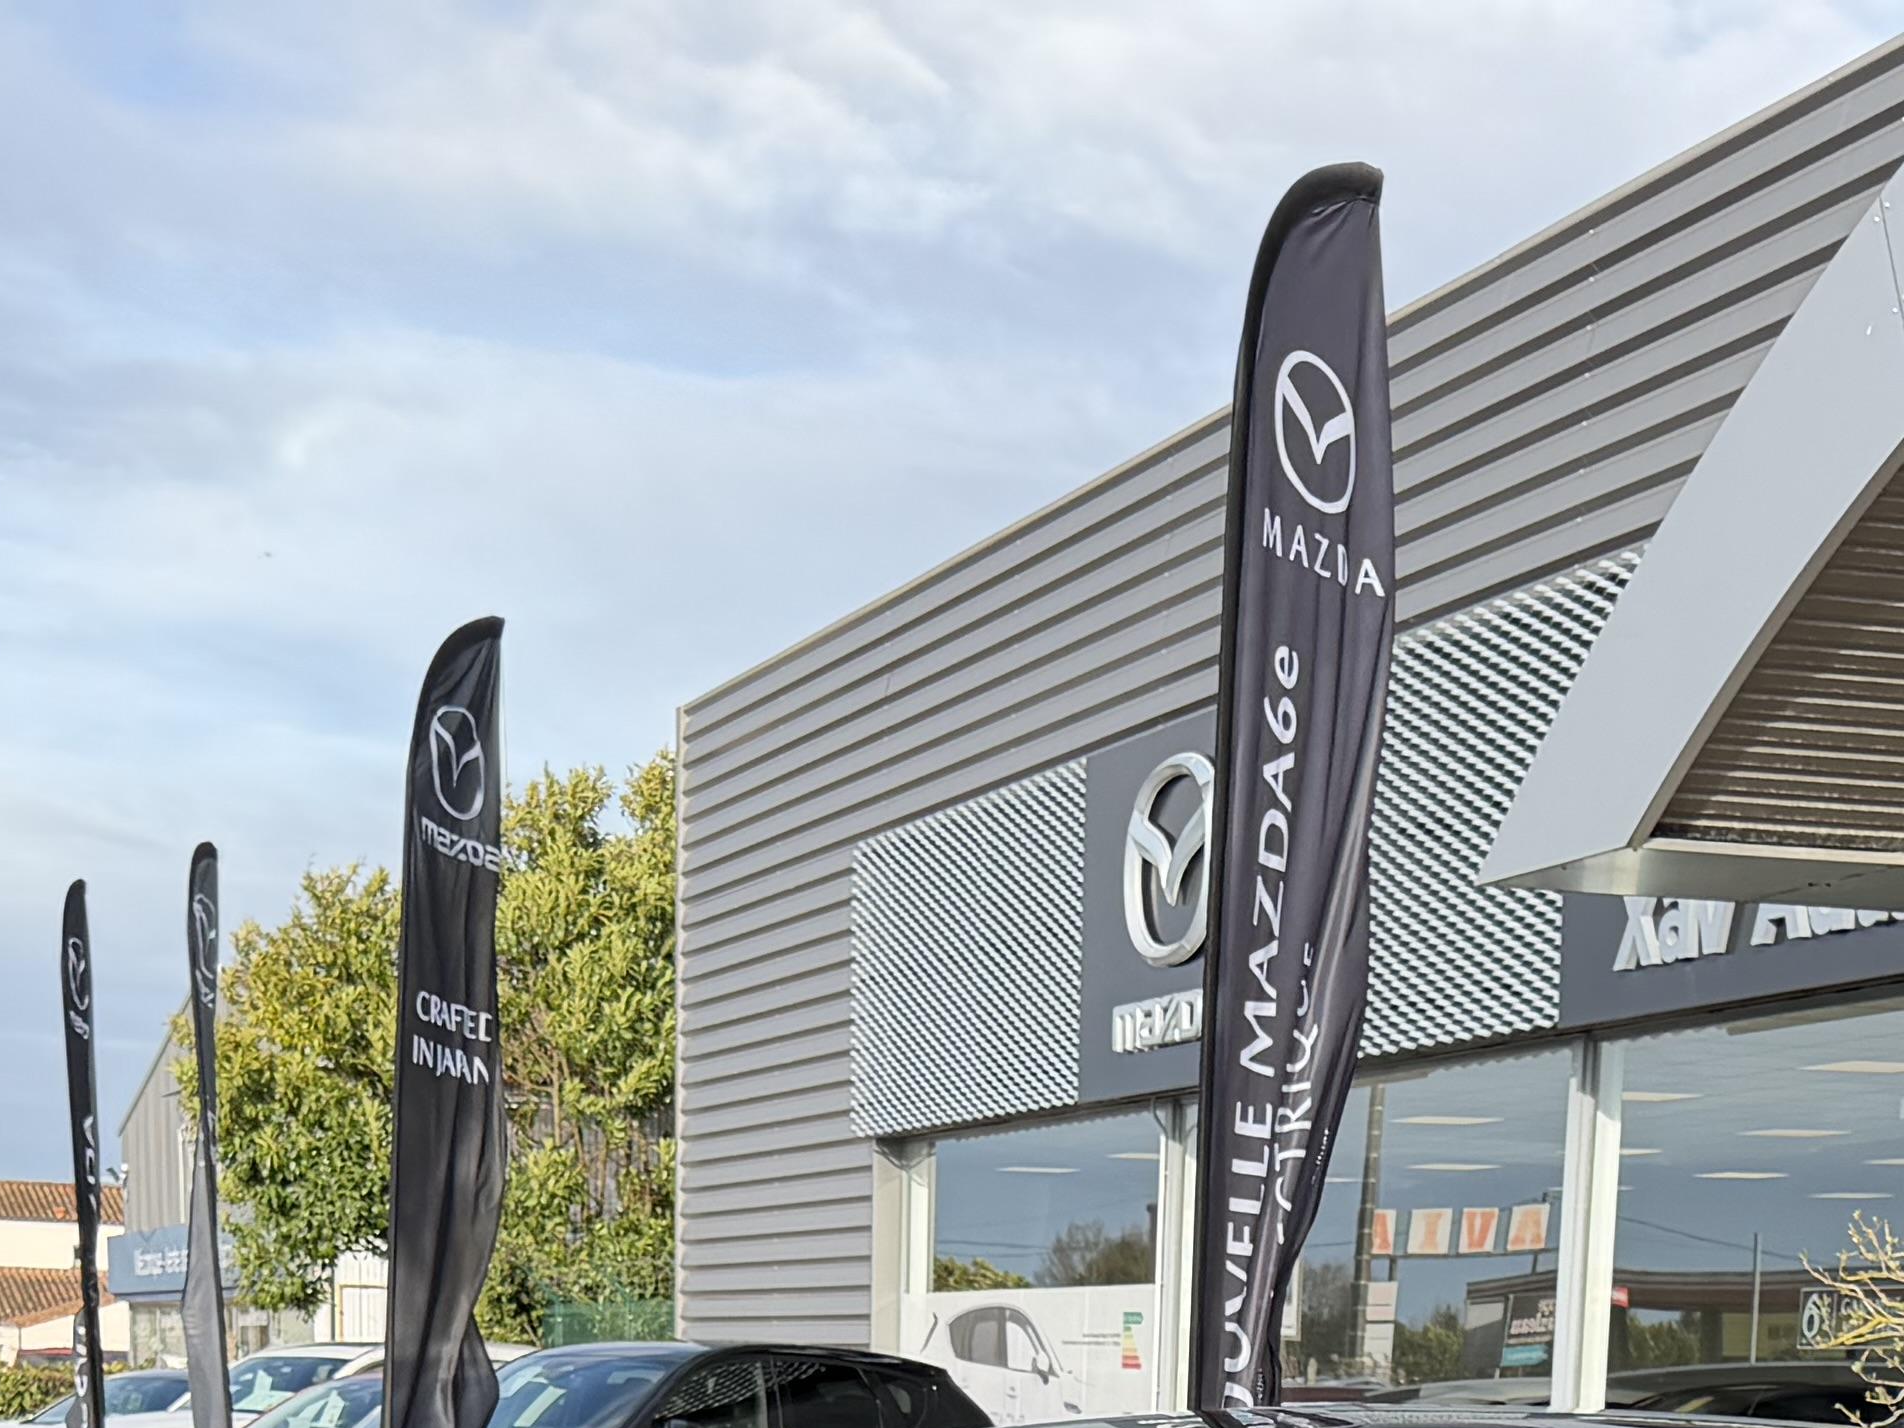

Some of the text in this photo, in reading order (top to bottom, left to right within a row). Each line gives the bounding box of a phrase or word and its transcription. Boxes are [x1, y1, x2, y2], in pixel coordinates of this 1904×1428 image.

[1262, 507, 1386, 598] MAZDA
[1239, 645, 1299, 1077] MAZDA6e
[412, 1033, 434, 1069] IN
[1112, 987, 1203, 1053] mazd
